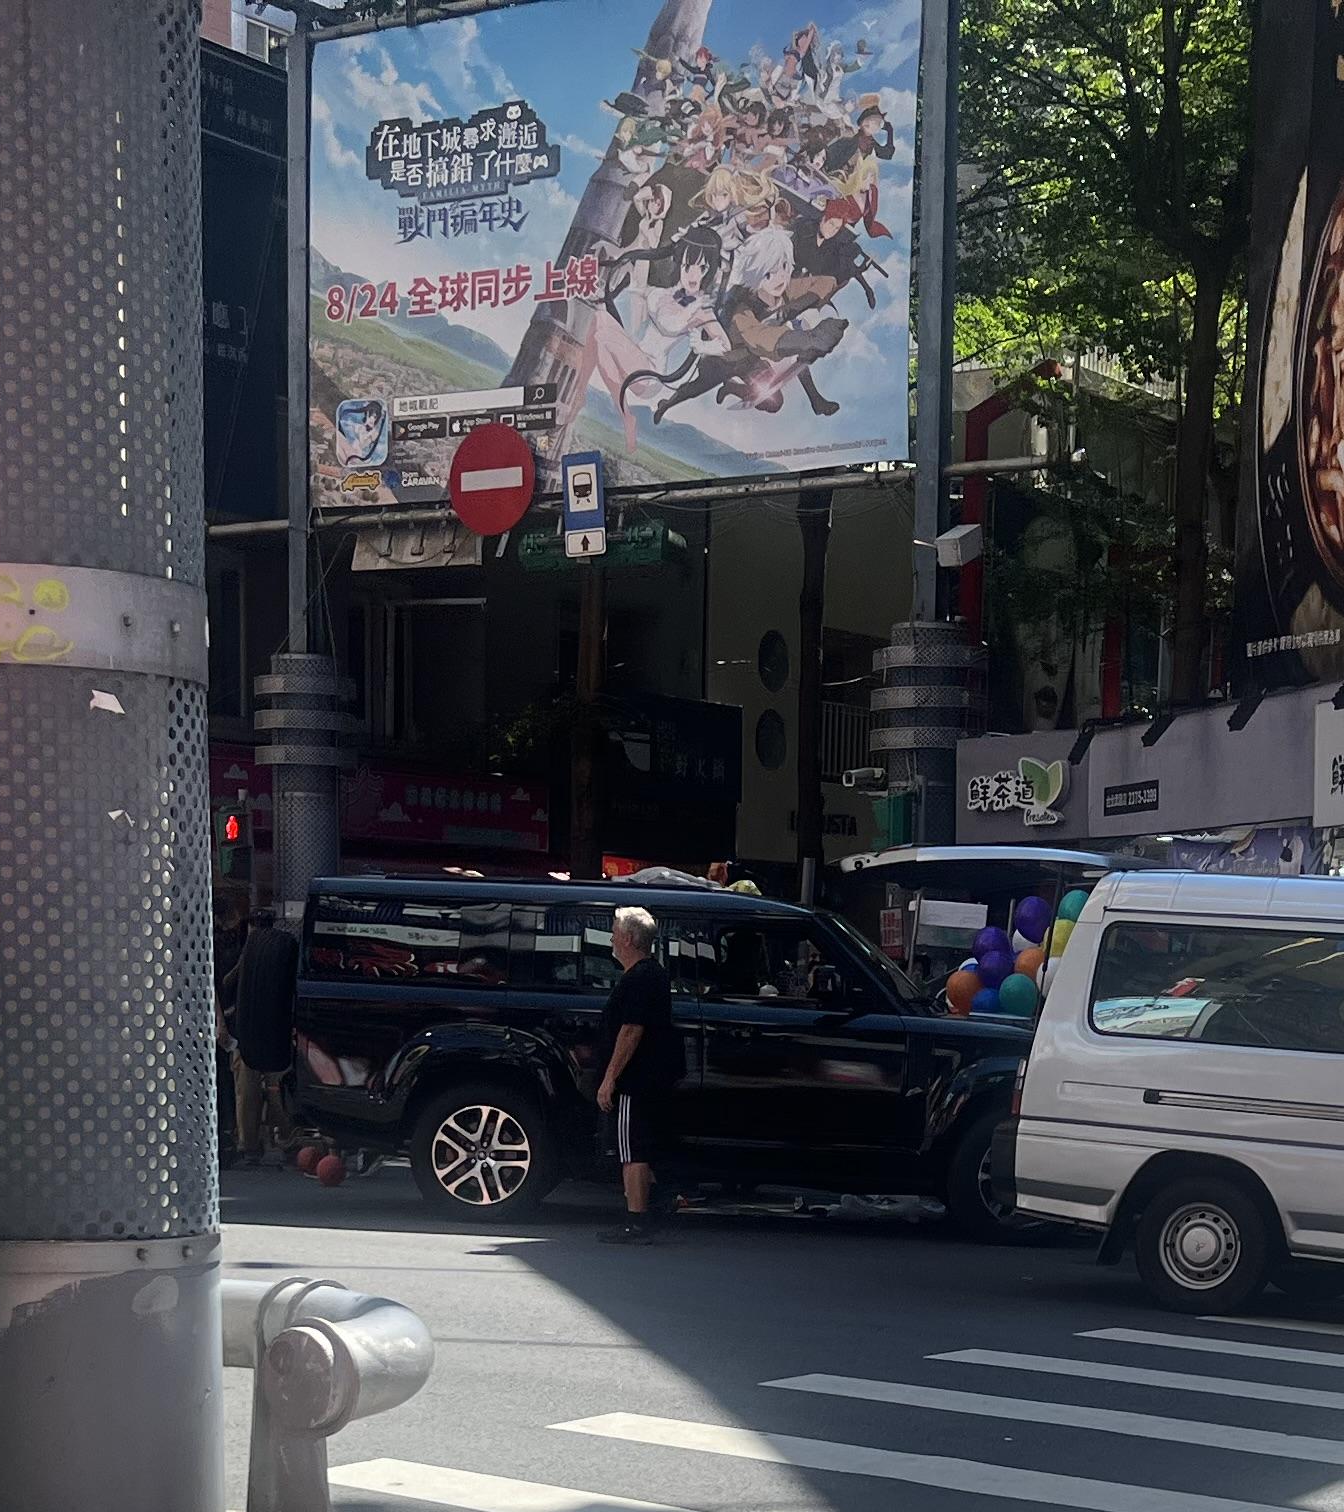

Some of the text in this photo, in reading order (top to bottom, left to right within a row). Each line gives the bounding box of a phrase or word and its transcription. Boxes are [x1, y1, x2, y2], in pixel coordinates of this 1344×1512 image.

[375, 118, 539, 162] 在地下城尋求邂逅
[390, 150, 532, 189] 是否搞錯了什麼
[326, 256, 600, 324] 8/24 全球同步上線
[968, 772, 1034, 808] 鮮茶道
